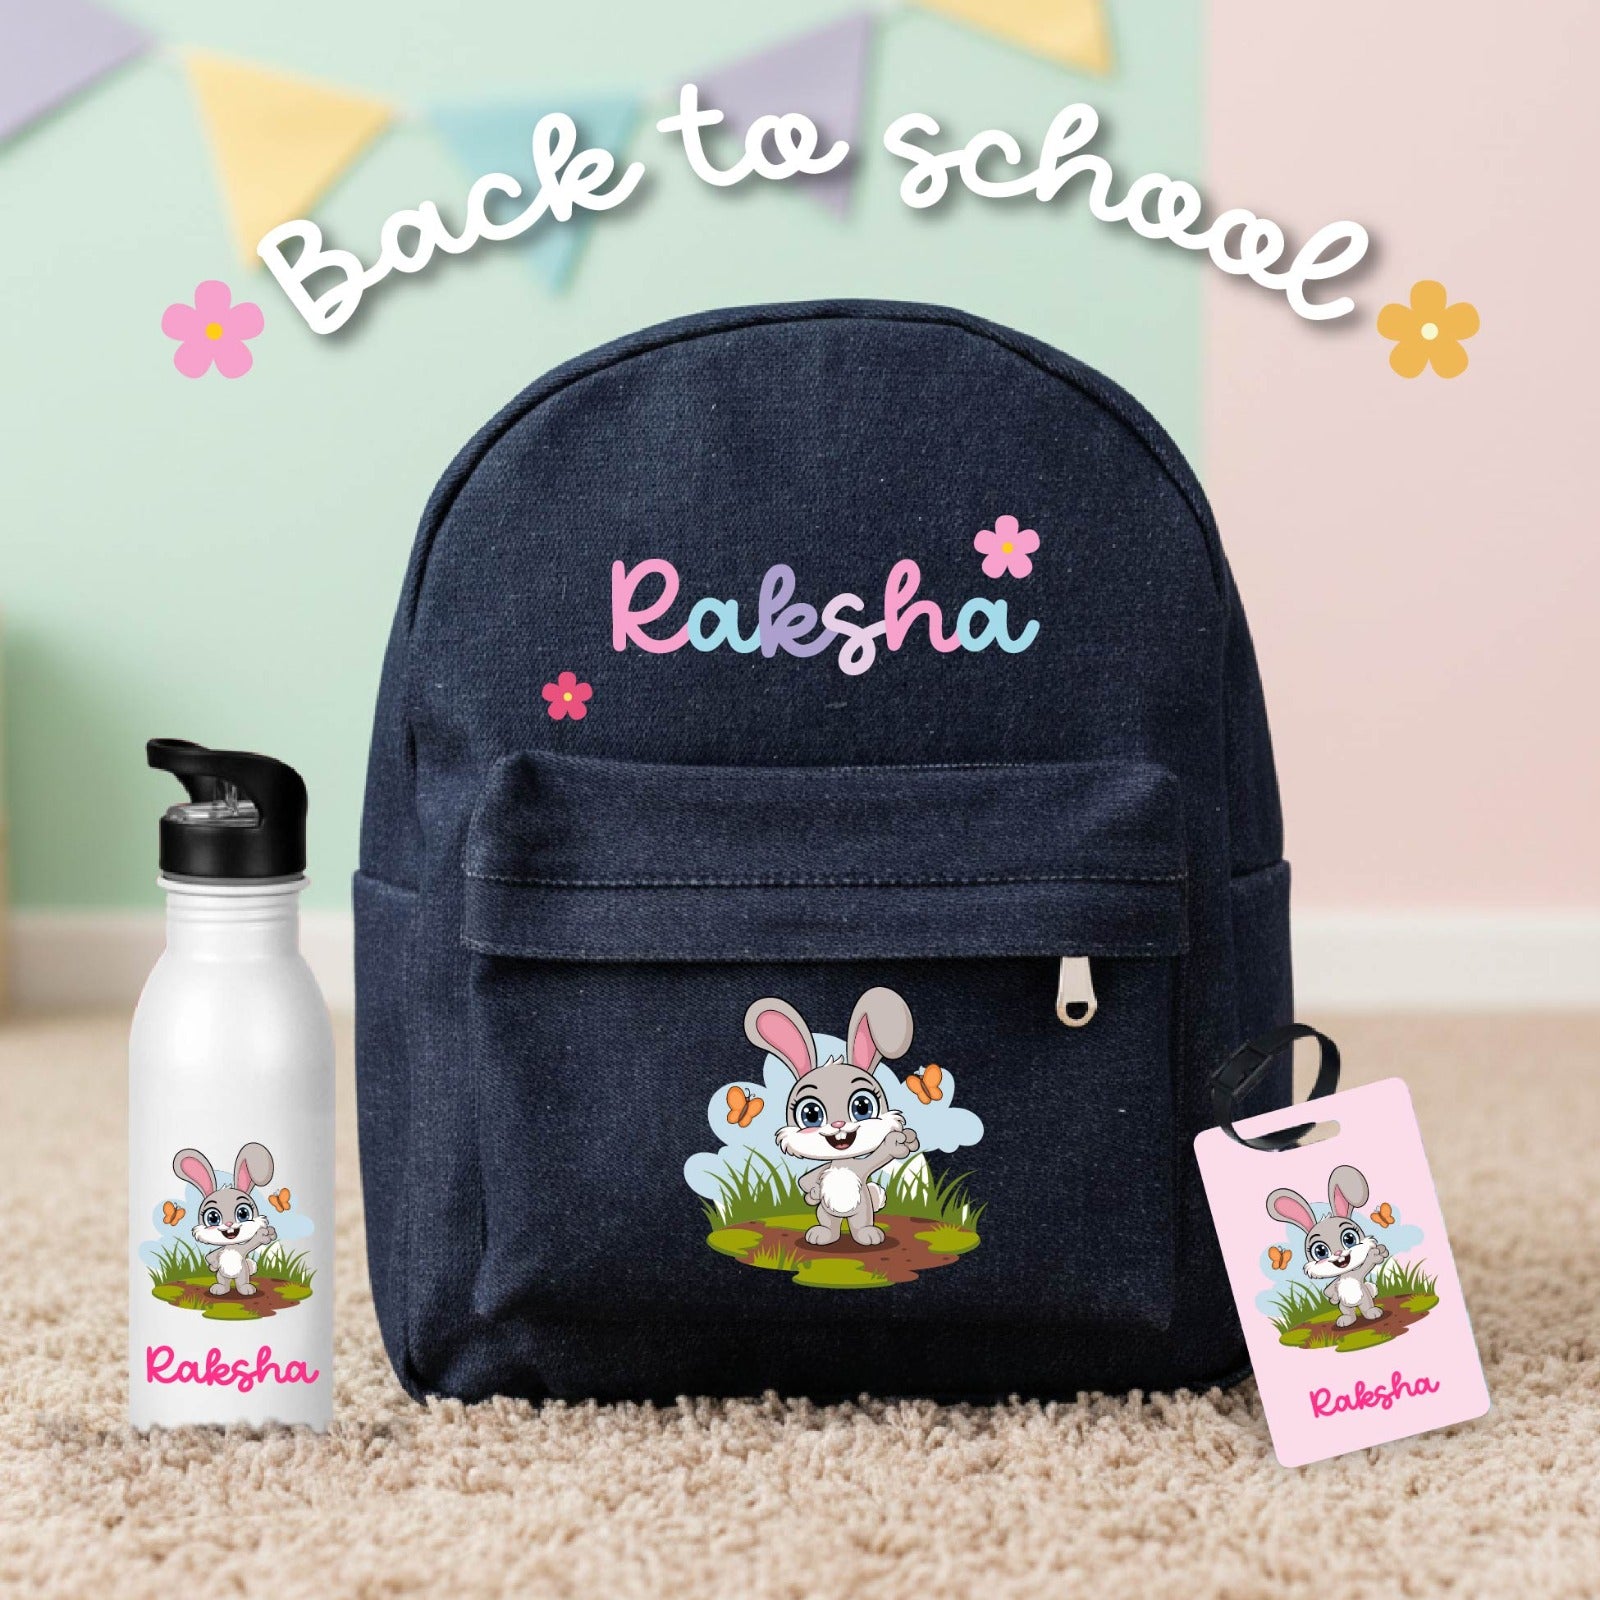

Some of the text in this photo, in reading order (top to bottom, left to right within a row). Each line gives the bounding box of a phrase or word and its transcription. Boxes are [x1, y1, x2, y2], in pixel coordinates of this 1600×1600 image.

[610, 558, 1041, 676] Raksha
[146, 1345, 320, 1393] Raksha
[1309, 1370, 1441, 1418] Raksha
